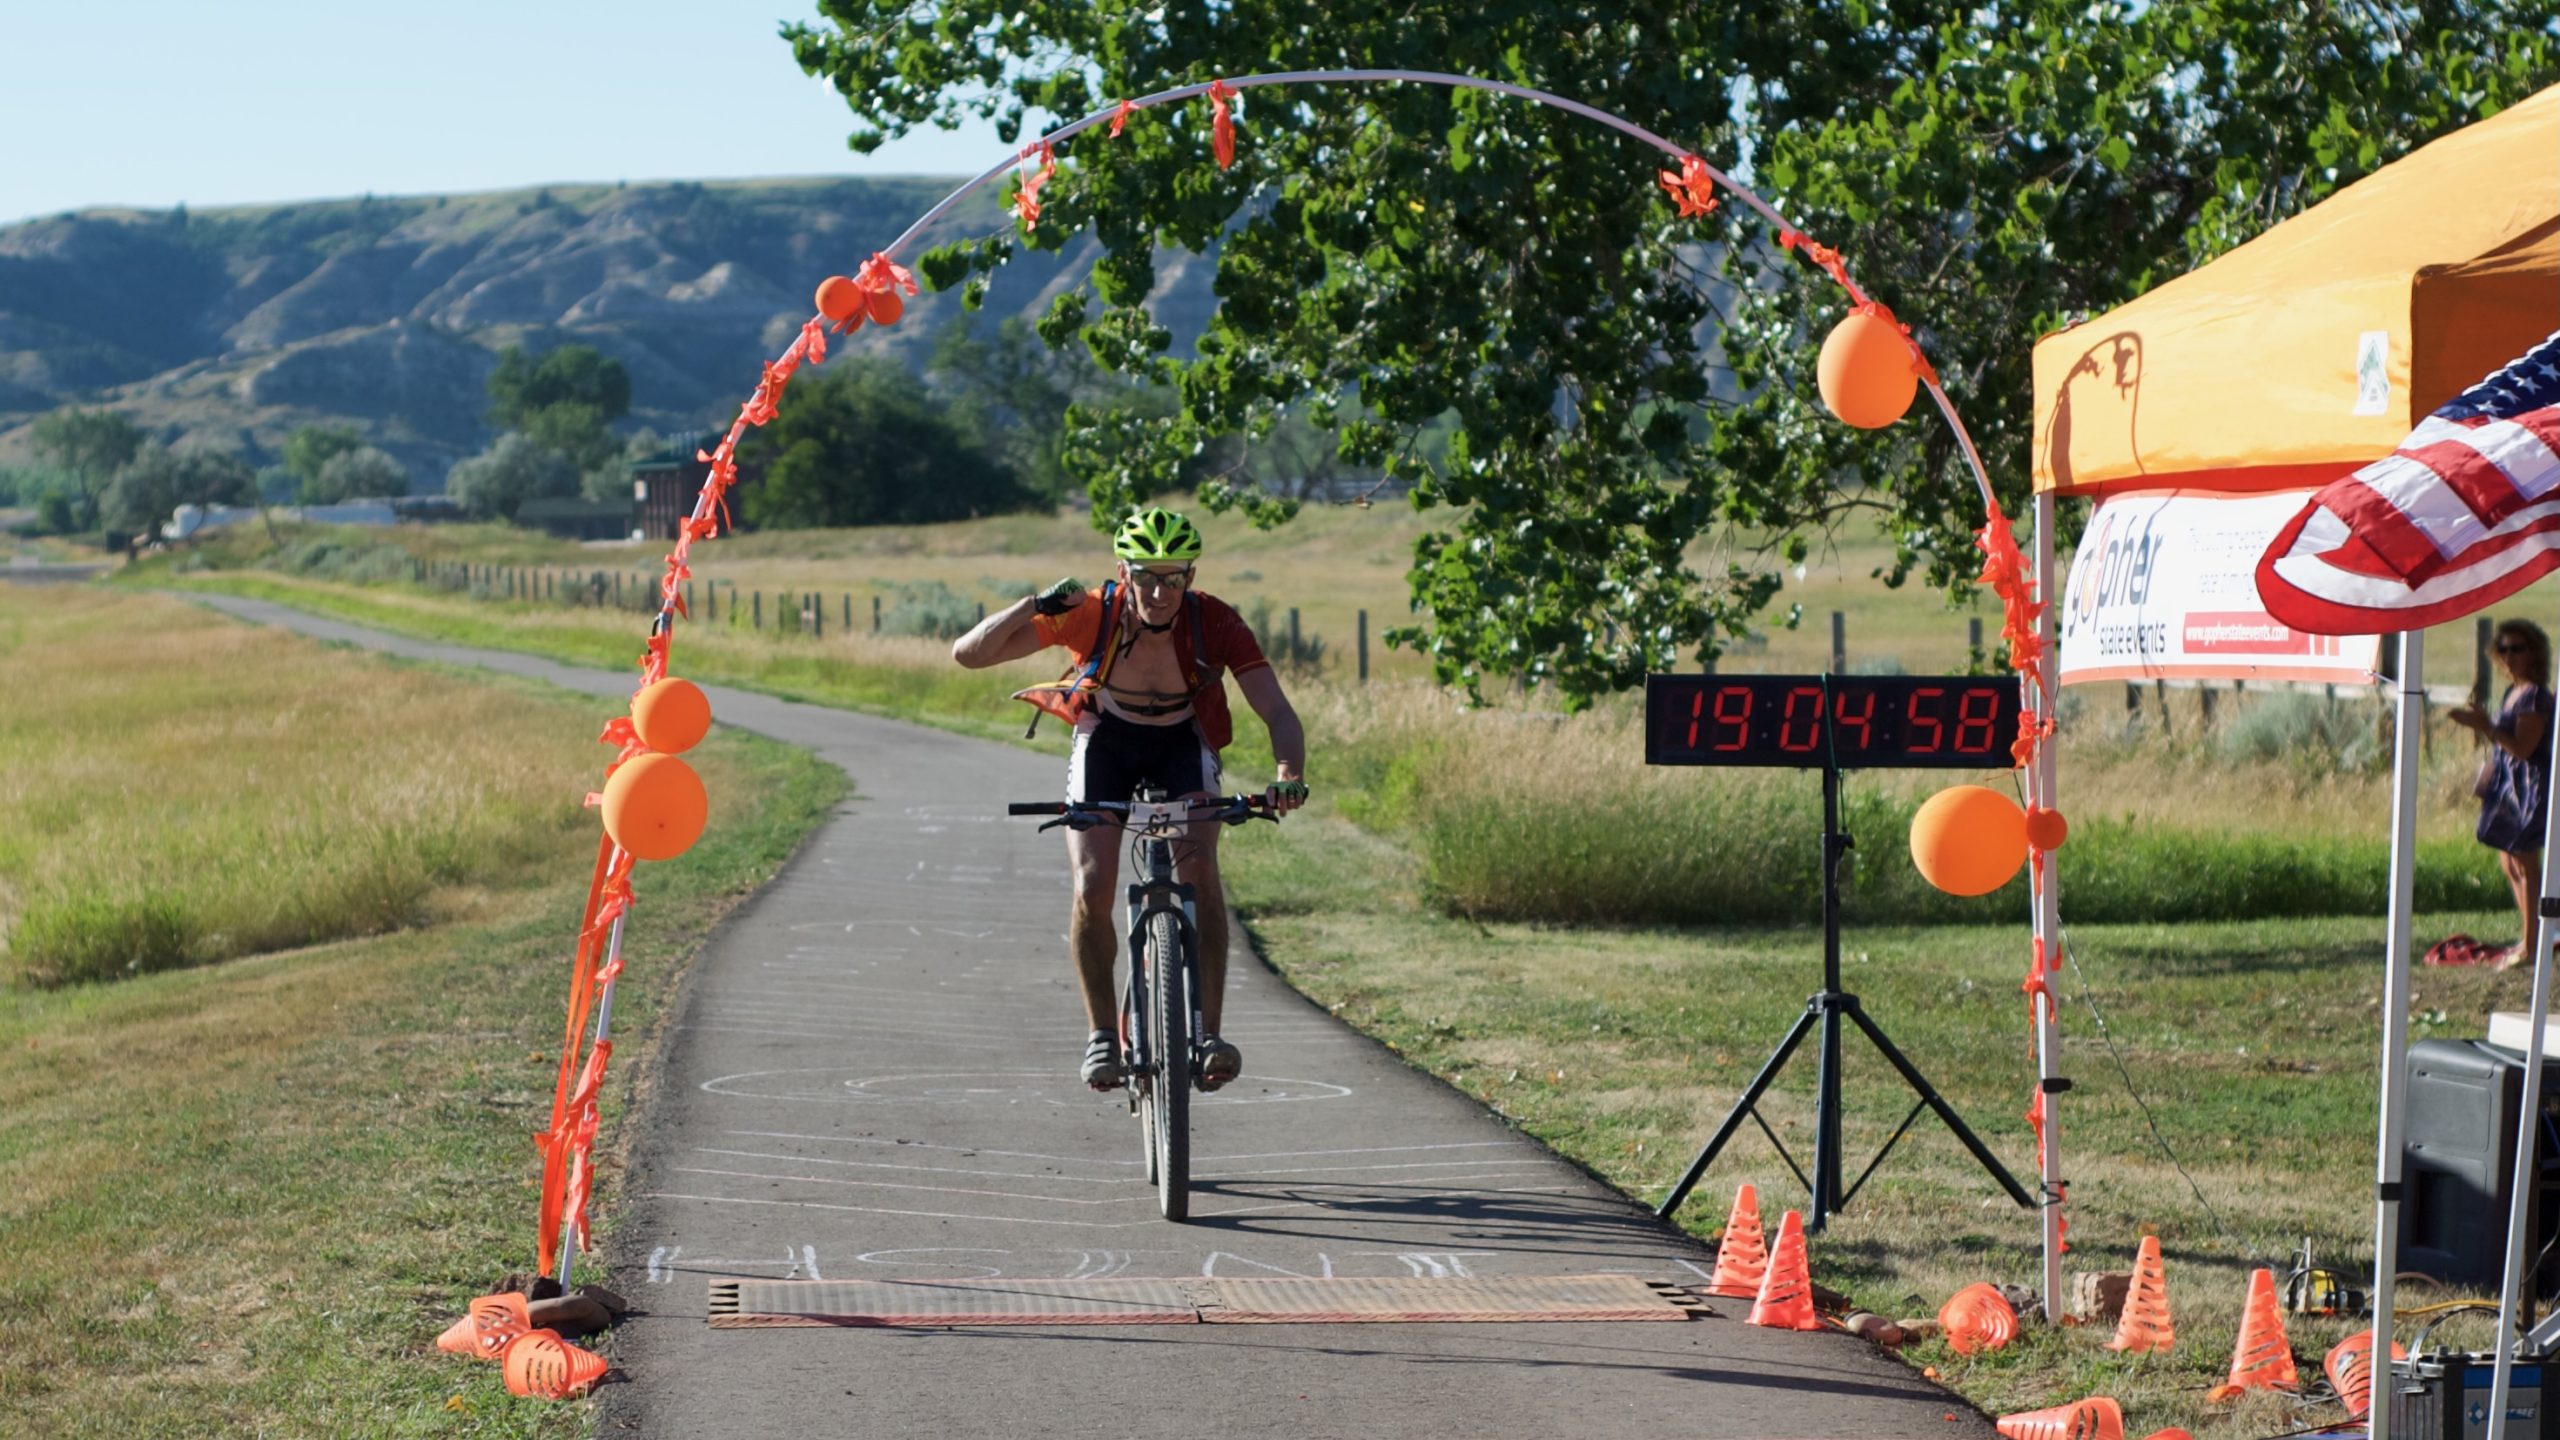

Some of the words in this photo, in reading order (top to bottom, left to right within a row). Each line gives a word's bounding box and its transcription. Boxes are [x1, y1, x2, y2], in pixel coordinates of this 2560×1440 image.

[2068, 513, 2163, 637] gopher
[2100, 624, 2124, 655] state
[2126, 621, 2165, 654] events
[1149, 813, 1171, 834] 67
